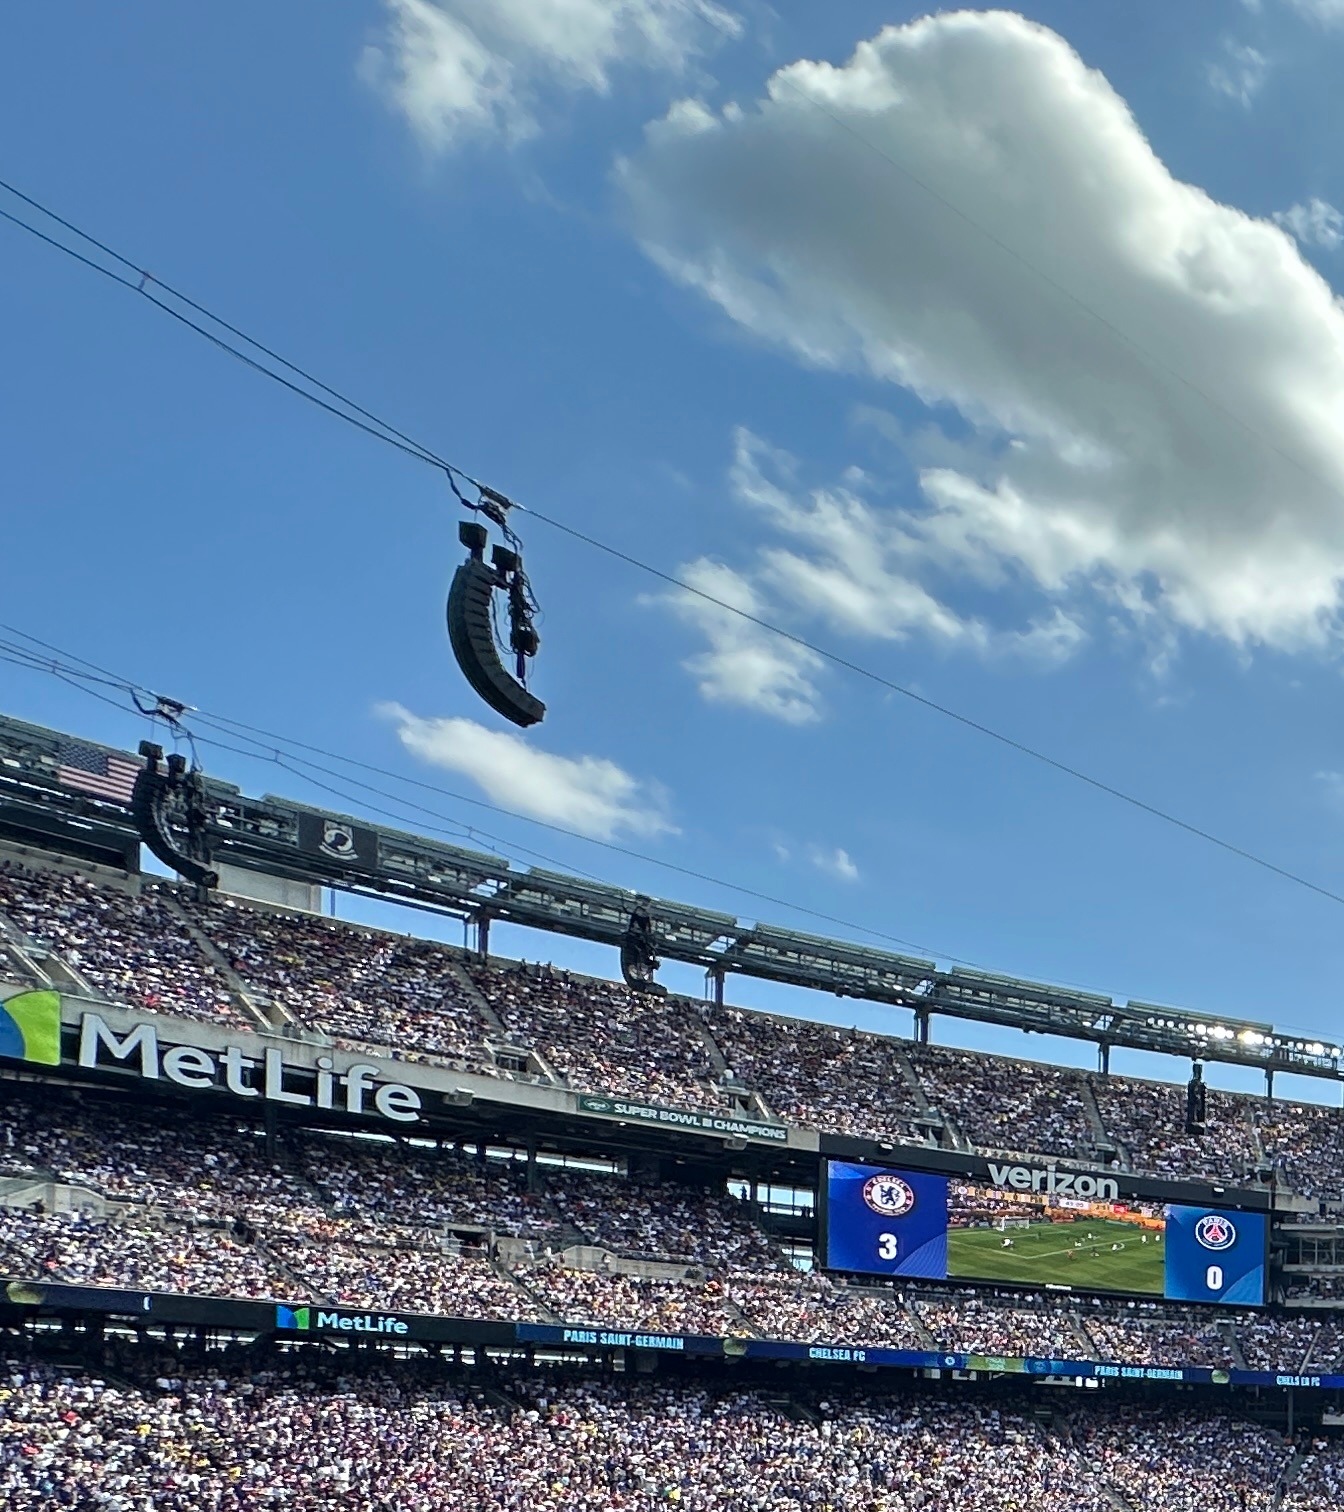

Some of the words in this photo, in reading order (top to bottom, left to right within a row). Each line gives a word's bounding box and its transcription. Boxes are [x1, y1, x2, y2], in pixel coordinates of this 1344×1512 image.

[78, 1012, 423, 1121] MetLife
[614, 1102, 657, 1119] SUPER
[659, 1111, 701, 1127] BOWL
[714, 1119, 787, 1140] CHAMPIONS
[986, 1163, 1119, 1200] verizon
[879, 1232, 897, 1260] 3
[1206, 1266, 1223, 1290] 0
[317, 1310, 409, 1335] MetLife
[563, 1330, 596, 1346] PARIS
[600, 1331, 684, 1350] SAINT-GERMAIN
[808, 1347, 851, 1361] CHELSEA
[854, 1350, 866, 1362] FC
